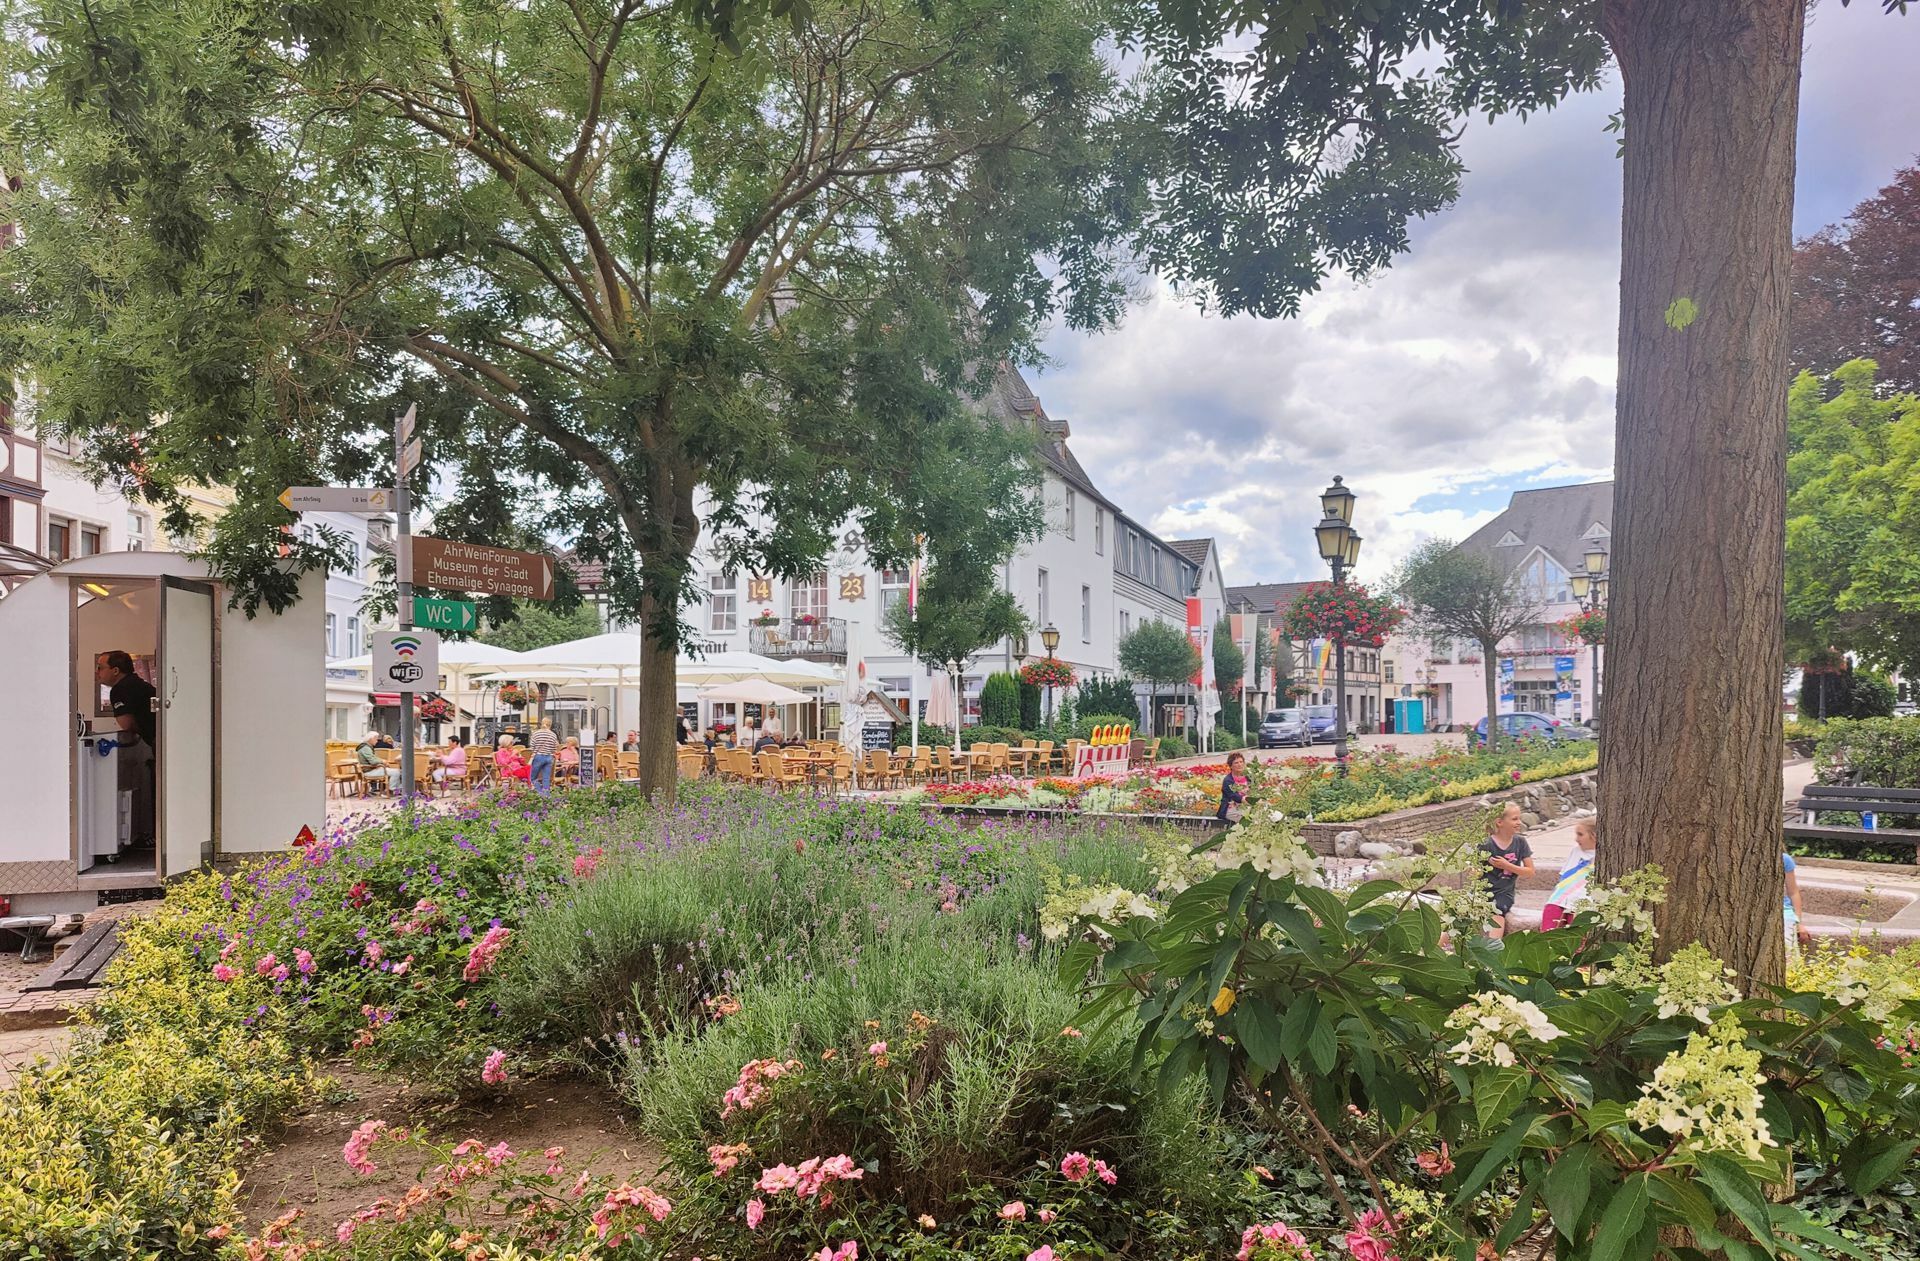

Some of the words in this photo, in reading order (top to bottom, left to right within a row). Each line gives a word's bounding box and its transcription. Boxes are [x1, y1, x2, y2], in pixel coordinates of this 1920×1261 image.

[443, 543, 520, 566] AhrWeinForum
[433, 557, 478, 574] Museum
[482, 563, 499, 577] der
[503, 566, 529, 581] Stadt
[427, 571, 483, 591] Ehemalige
[487, 578, 534, 597] Synagoge
[750, 581, 769, 598] 14
[842, 578, 863, 597] 23
[425, 604, 452, 624] WC
[391, 668, 420, 678] WiFi
